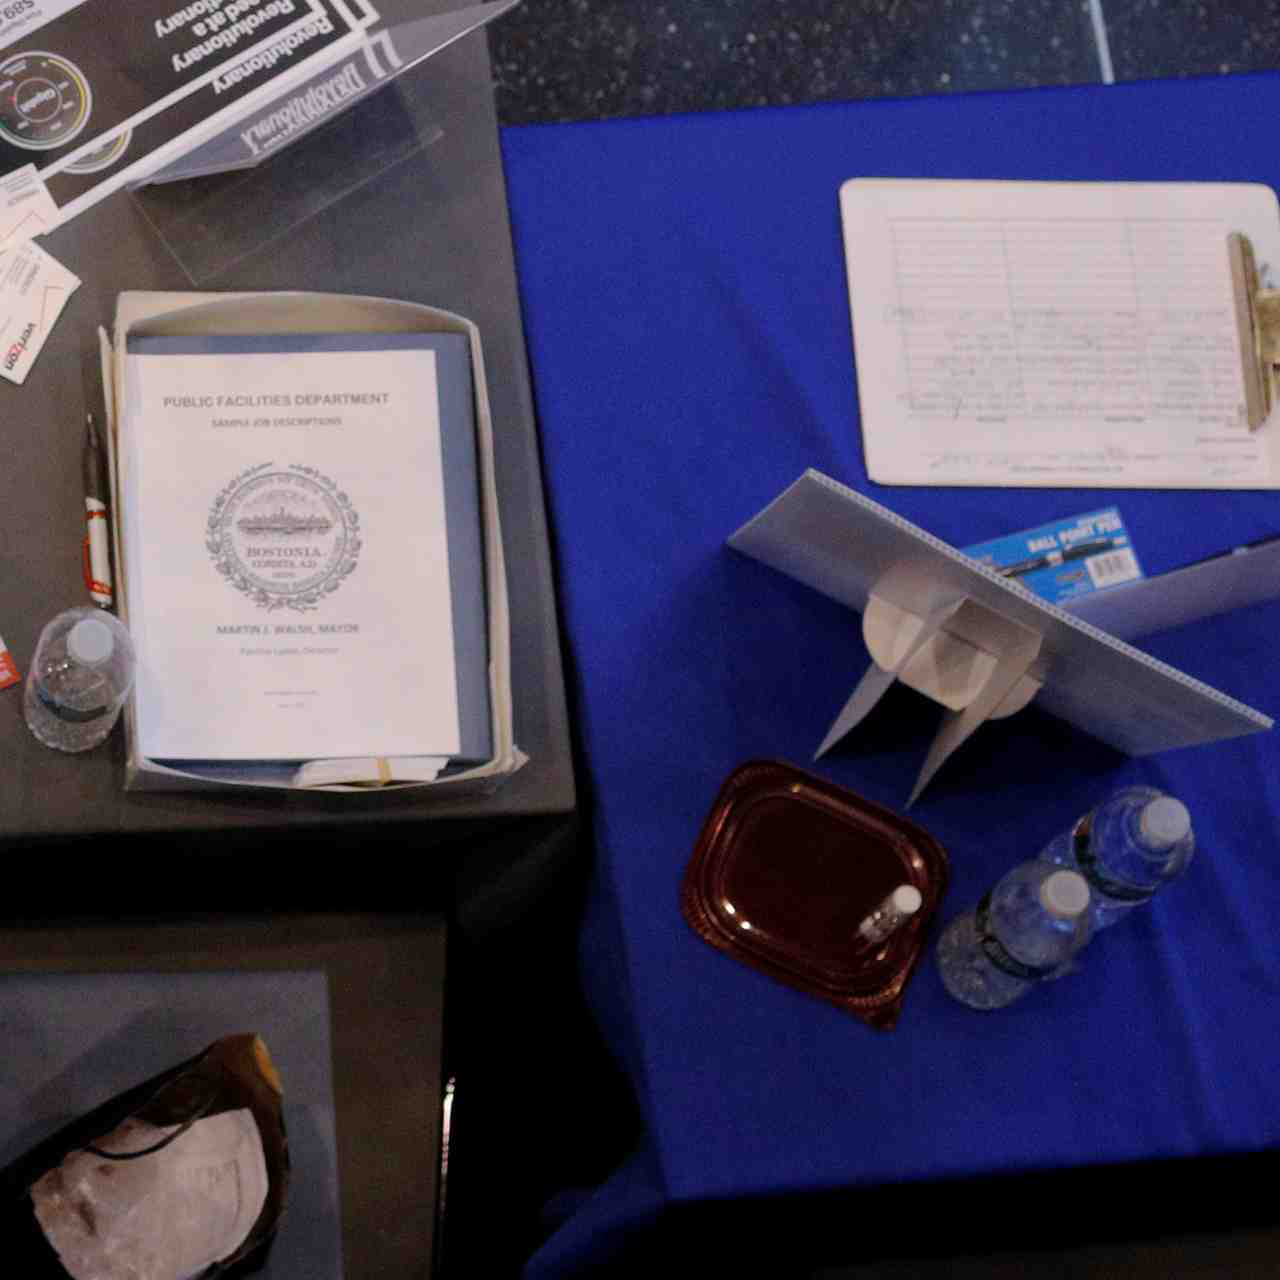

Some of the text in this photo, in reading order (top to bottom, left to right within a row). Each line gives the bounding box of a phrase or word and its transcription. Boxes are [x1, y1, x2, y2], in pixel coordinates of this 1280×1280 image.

[190, 19, 208, 37] a
[204, 9, 228, 31] at
[0, 320, 40, 372] verizon
[163, 393, 390, 408] PUBLIC FACILITIES DEPARTMENT
